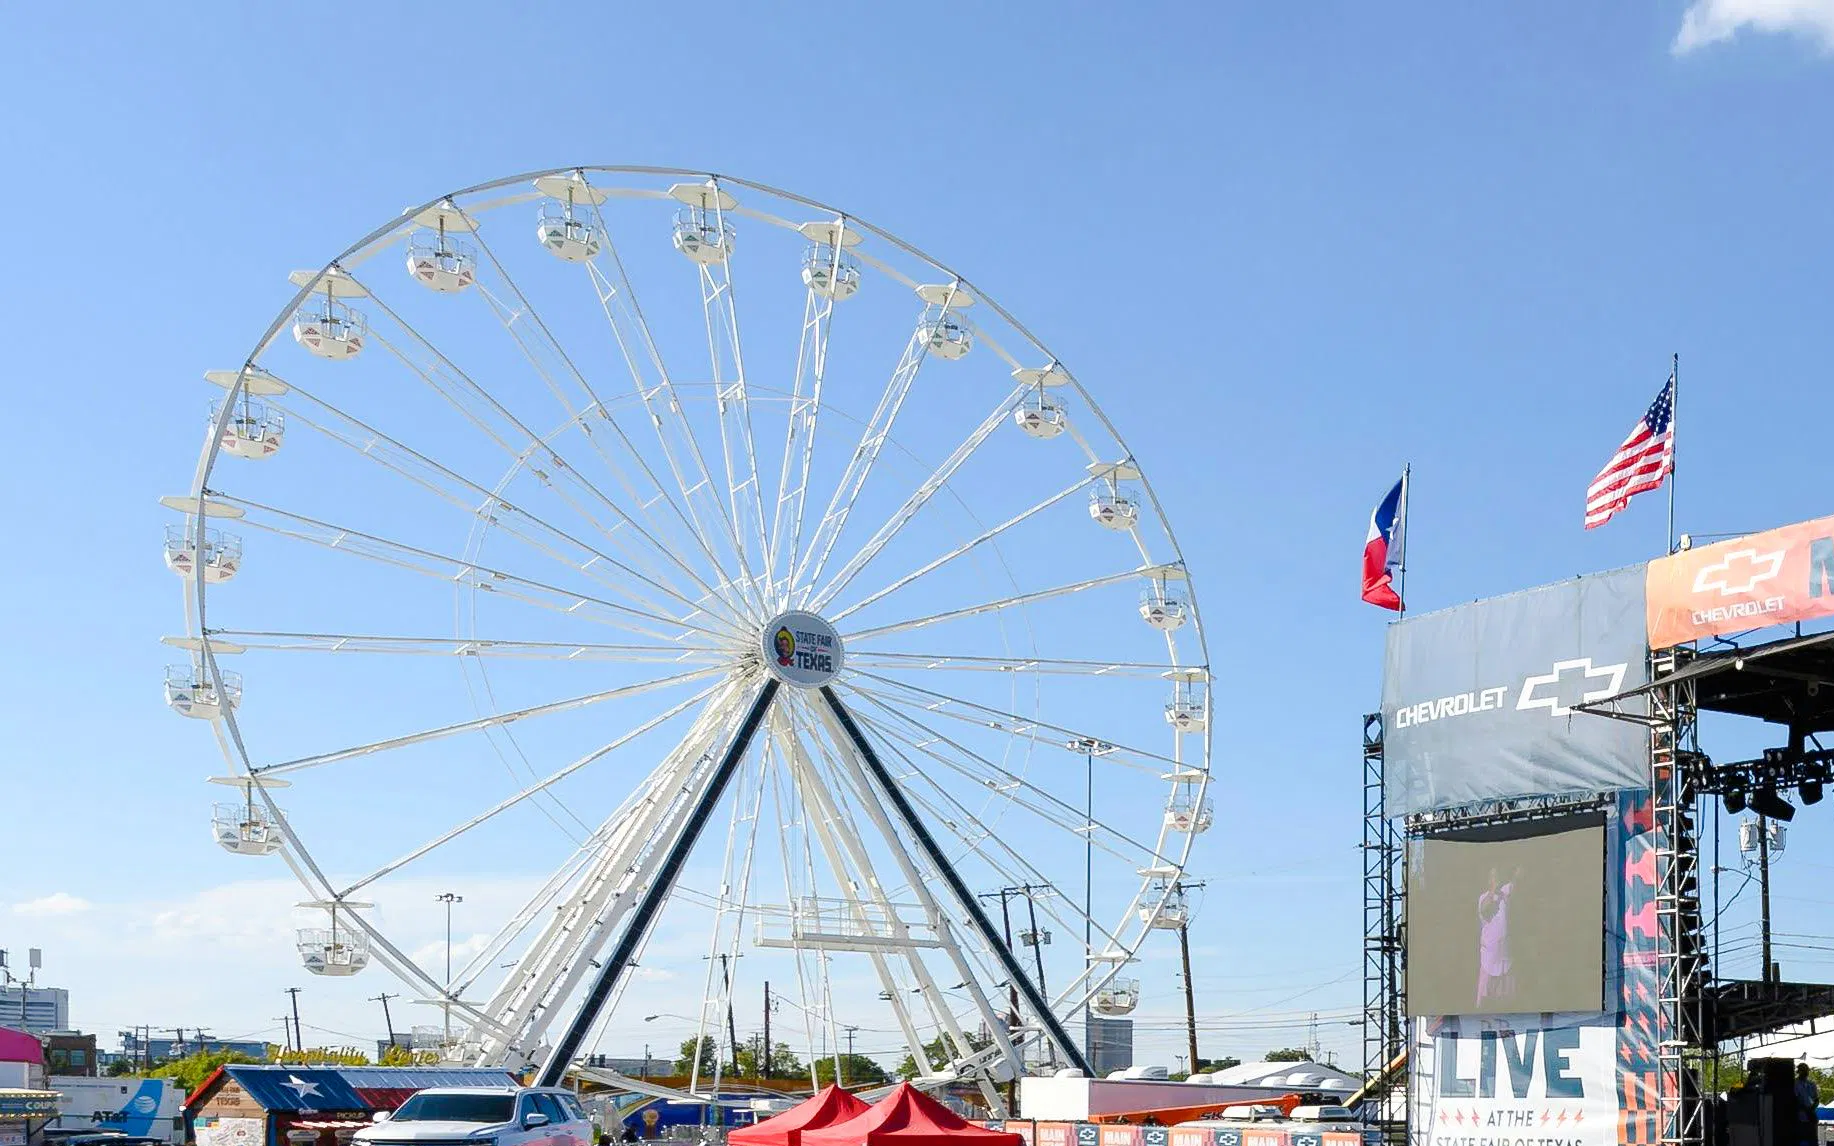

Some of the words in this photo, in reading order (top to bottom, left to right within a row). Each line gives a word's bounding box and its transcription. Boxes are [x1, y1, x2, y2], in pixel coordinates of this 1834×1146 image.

[1691, 595, 1786, 626] CHEVROLET
[796, 631, 816, 645] STATE
[796, 651, 832, 672] TEXAS
[1396, 686, 1508, 729] CHEVROLET
[1440, 1025, 1585, 1098] LIVE
[91, 1110, 130, 1122] AT&T
[1487, 1110, 1505, 1126] AT
[1507, 1110, 1533, 1127] THE
